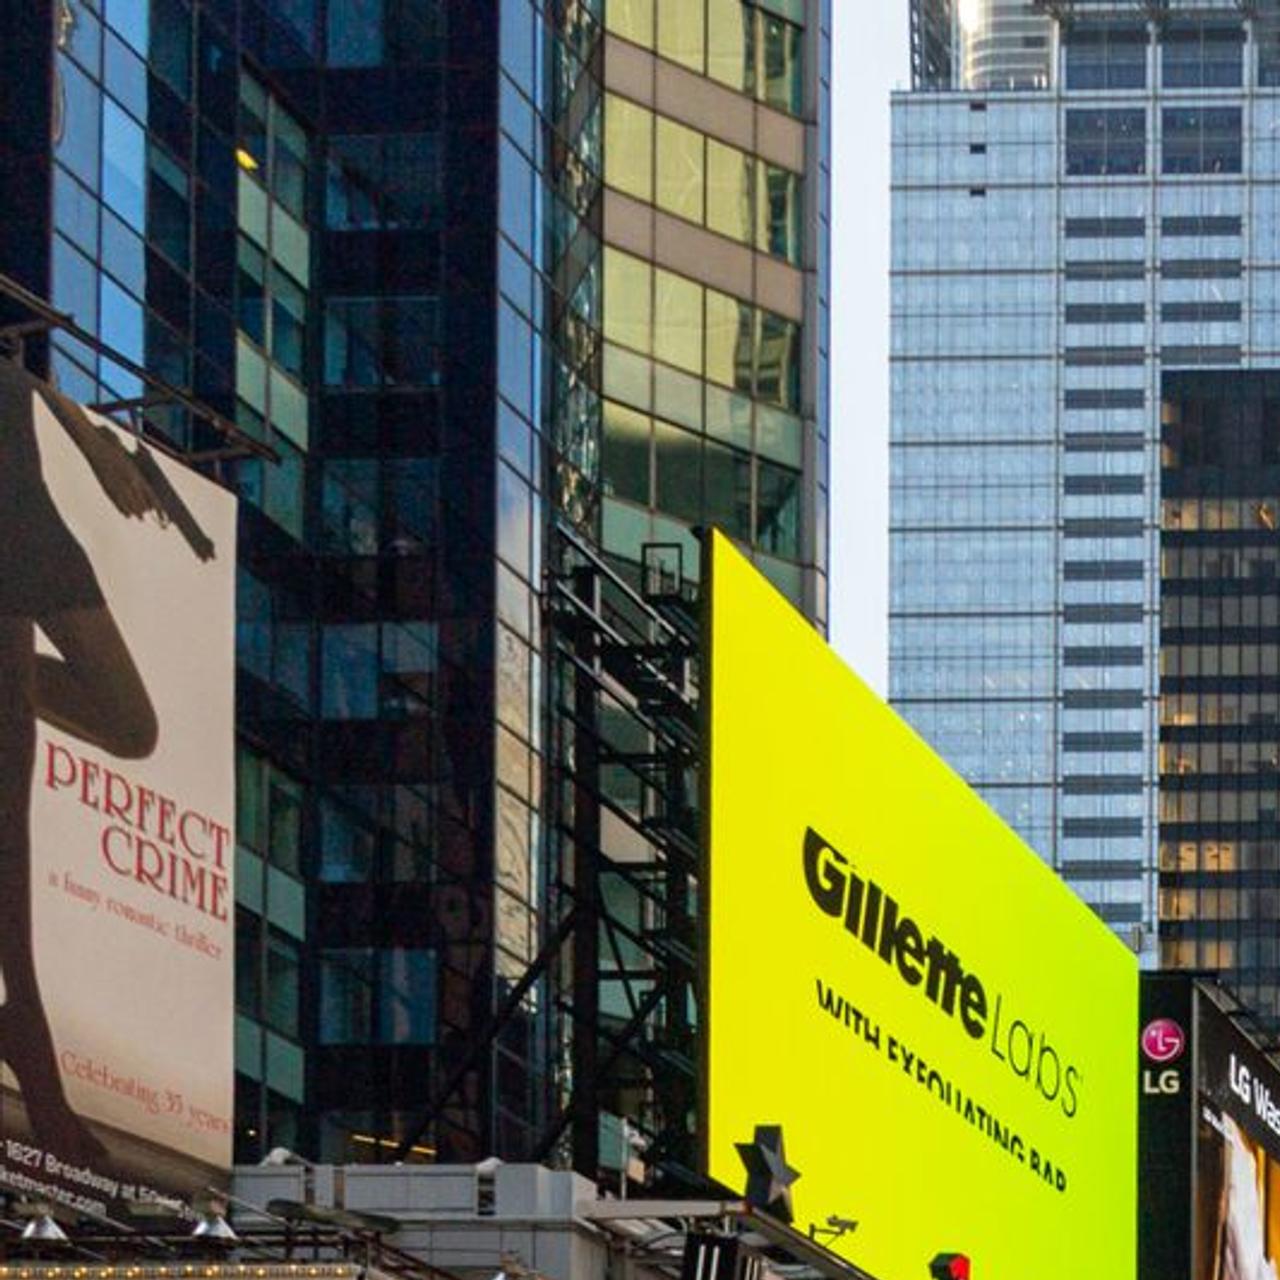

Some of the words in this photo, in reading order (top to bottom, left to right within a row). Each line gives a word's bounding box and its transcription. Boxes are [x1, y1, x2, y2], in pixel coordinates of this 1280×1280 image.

[45, 740, 230, 871] PERFECT
[101, 824, 228, 924] CRIME
[803, 825, 988, 1040] Gillette
[991, 994, 1078, 1118] Labs
[60, 1051, 159, 1115] Celebrating
[1143, 1070, 1180, 1095] LG
[1229, 1053, 1250, 1105] LG
[6, 1140, 43, 1168] 1627
[45, 1154, 119, 1196] Broadway
